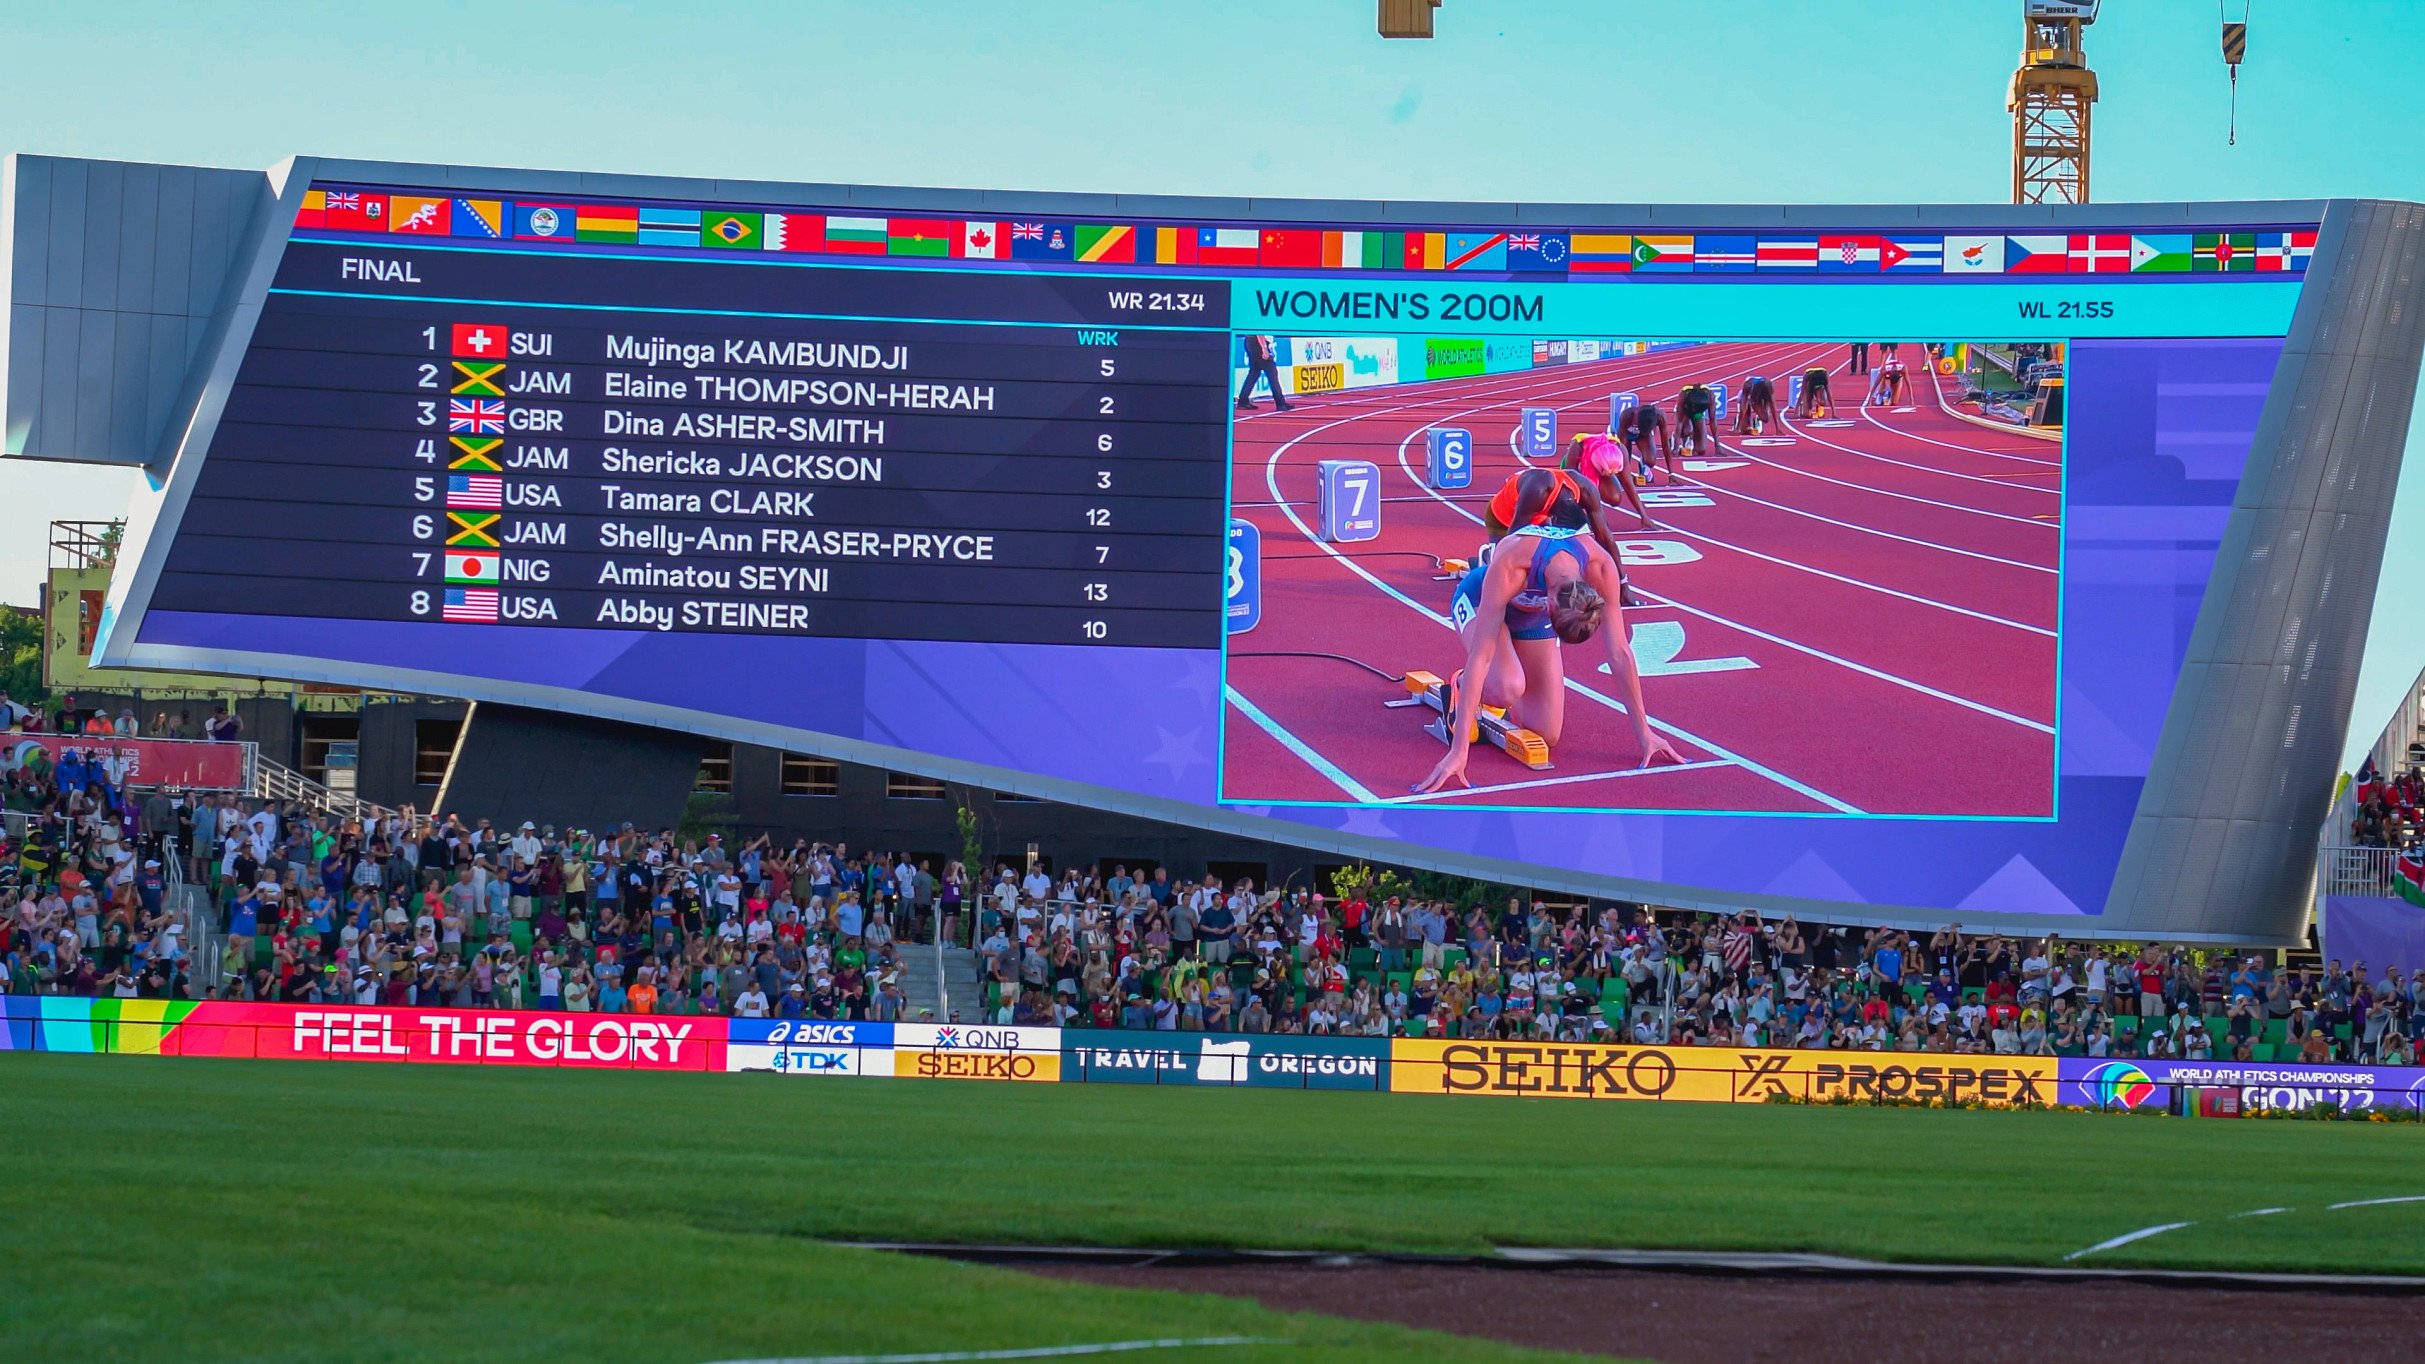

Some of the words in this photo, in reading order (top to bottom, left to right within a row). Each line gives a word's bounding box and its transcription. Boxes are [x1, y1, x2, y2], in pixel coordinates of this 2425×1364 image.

[343, 258, 420, 282] FINAL
[1109, 292, 1142, 309] WR
[1149, 293, 1204, 310] 21.34
[1256, 291, 1429, 320] WOMEN'S
[1441, 294, 1543, 321] 200M
[2019, 302, 2051, 318] WL
[2058, 302, 2113, 318] 21.55
[423, 327, 434, 349] 1
[511, 333, 551, 355] SUI
[607, 335, 714, 368] Mujinga
[725, 340, 907, 369] KAMBUNDJI
[1077, 330, 1119, 346] WRK
[1315, 342, 1332, 359] QNB
[1101, 360, 1114, 376] 5
[1301, 365, 1337, 390] SEIKO
[419, 364, 438, 387] 2
[509, 371, 570, 393] JAM
[606, 373, 686, 398] Elaine
[695, 376, 993, 410] THOMPSON-HERAH
[1100, 397, 1113, 413] 2
[417, 402, 436, 425] 3
[509, 408, 562, 431] GBR
[605, 410, 663, 435] Dina
[673, 413, 883, 444] ASHER-SMITH
[1535, 419, 1550, 442] 5
[1098, 434, 1112, 451] 6
[415, 440, 435, 463] 4
[507, 446, 568, 469] JAM
[603, 448, 720, 475] Shericka
[729, 453, 881, 481] JACKSON
[1445, 441, 1464, 470] 6
[1098, 472, 1111, 488] 3
[415, 478, 433, 501] 5
[506, 484, 561, 506] USA
[601, 486, 700, 512] Tamara
[711, 490, 813, 516] CLARK
[1345, 479, 1369, 517] 7
[1087, 509, 1110, 526] 12
[413, 515, 433, 538] 6
[504, 522, 565, 544] JAM
[600, 523, 752, 555] Shelly-Ann
[762, 529, 993, 560] FRASER-PRYCE
[1096, 547, 1109, 563] 7
[413, 553, 431, 576] 7
[504, 559, 549, 581] NIG
[598, 561, 730, 588] Aminatou
[739, 566, 828, 591] SEYNI
[1084, 584, 1108, 601] 13
[411, 591, 429, 614] 8
[502, 597, 557, 619] USA
[597, 599, 673, 630] Abby
[682, 602, 808, 628] STEINER
[1458, 603, 1468, 624] 8
[1083, 622, 1106, 638] 10
[94, 747, 140, 756] ATHLTICS
[294, 1012, 409, 1054] FEEL
[419, 1016, 515, 1057] THE
[526, 1018, 693, 1063] GLORY
[795, 1025, 855, 1044] asics
[965, 1030, 1020, 1049] QNB
[790, 1052, 848, 1071] TDK
[918, 1053, 1036, 1078] SEIKO
[1075, 1047, 1187, 1069] TRAVEL
[1260, 1053, 1377, 1076] OREGON
[1442, 1044, 1676, 1096] SEIKO
[1816, 1063, 2044, 1101] PROSPEX
[2169, 1068, 2213, 1079] WORLD
[2215, 1069, 2278, 1081] ATHLETICS
[2280, 1071, 2375, 1085] CHAMPIONSHIPS
